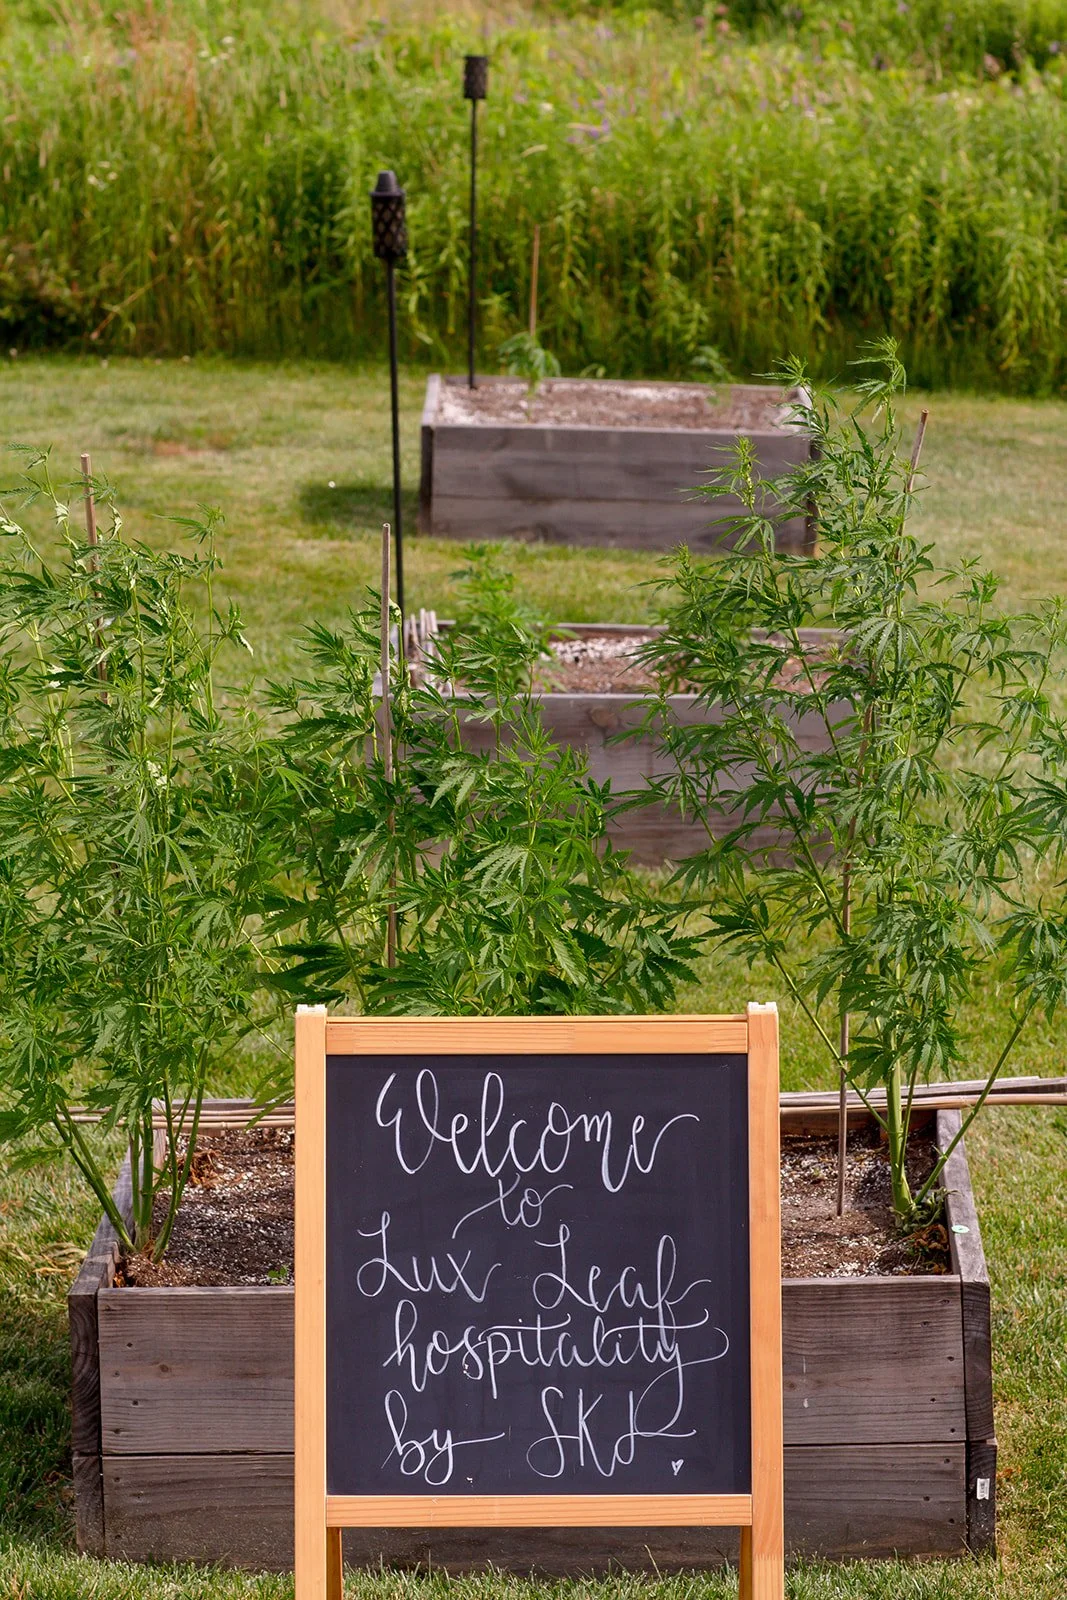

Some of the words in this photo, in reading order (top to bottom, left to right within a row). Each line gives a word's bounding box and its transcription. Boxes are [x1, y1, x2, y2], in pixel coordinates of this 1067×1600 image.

[376, 1068, 700, 1192] Welcome
[452, 1173, 573, 1239] to
[357, 1211, 502, 1302] Lux
[533, 1223, 712, 1351] Leaf
[383, 1299, 730, 1437] hospitality
[381, 1389, 506, 1486] by
